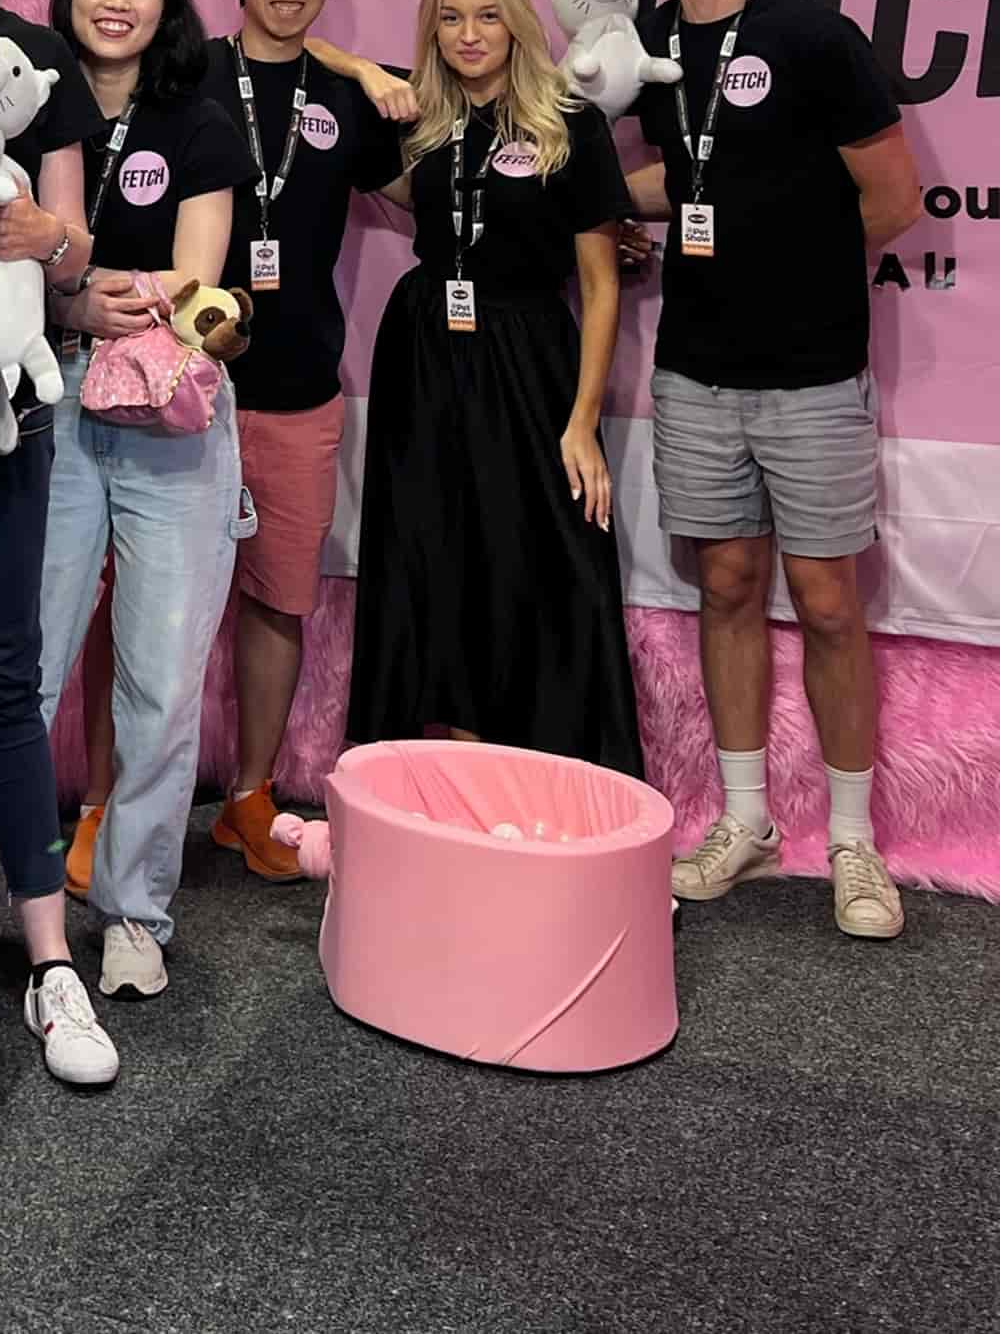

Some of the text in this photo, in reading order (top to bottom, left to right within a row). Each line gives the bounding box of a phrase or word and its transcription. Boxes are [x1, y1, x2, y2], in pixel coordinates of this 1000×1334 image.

[725, 71, 768, 91] FETCH
[302, 116, 336, 136] FETCH
[122, 166, 165, 189] FETCH
